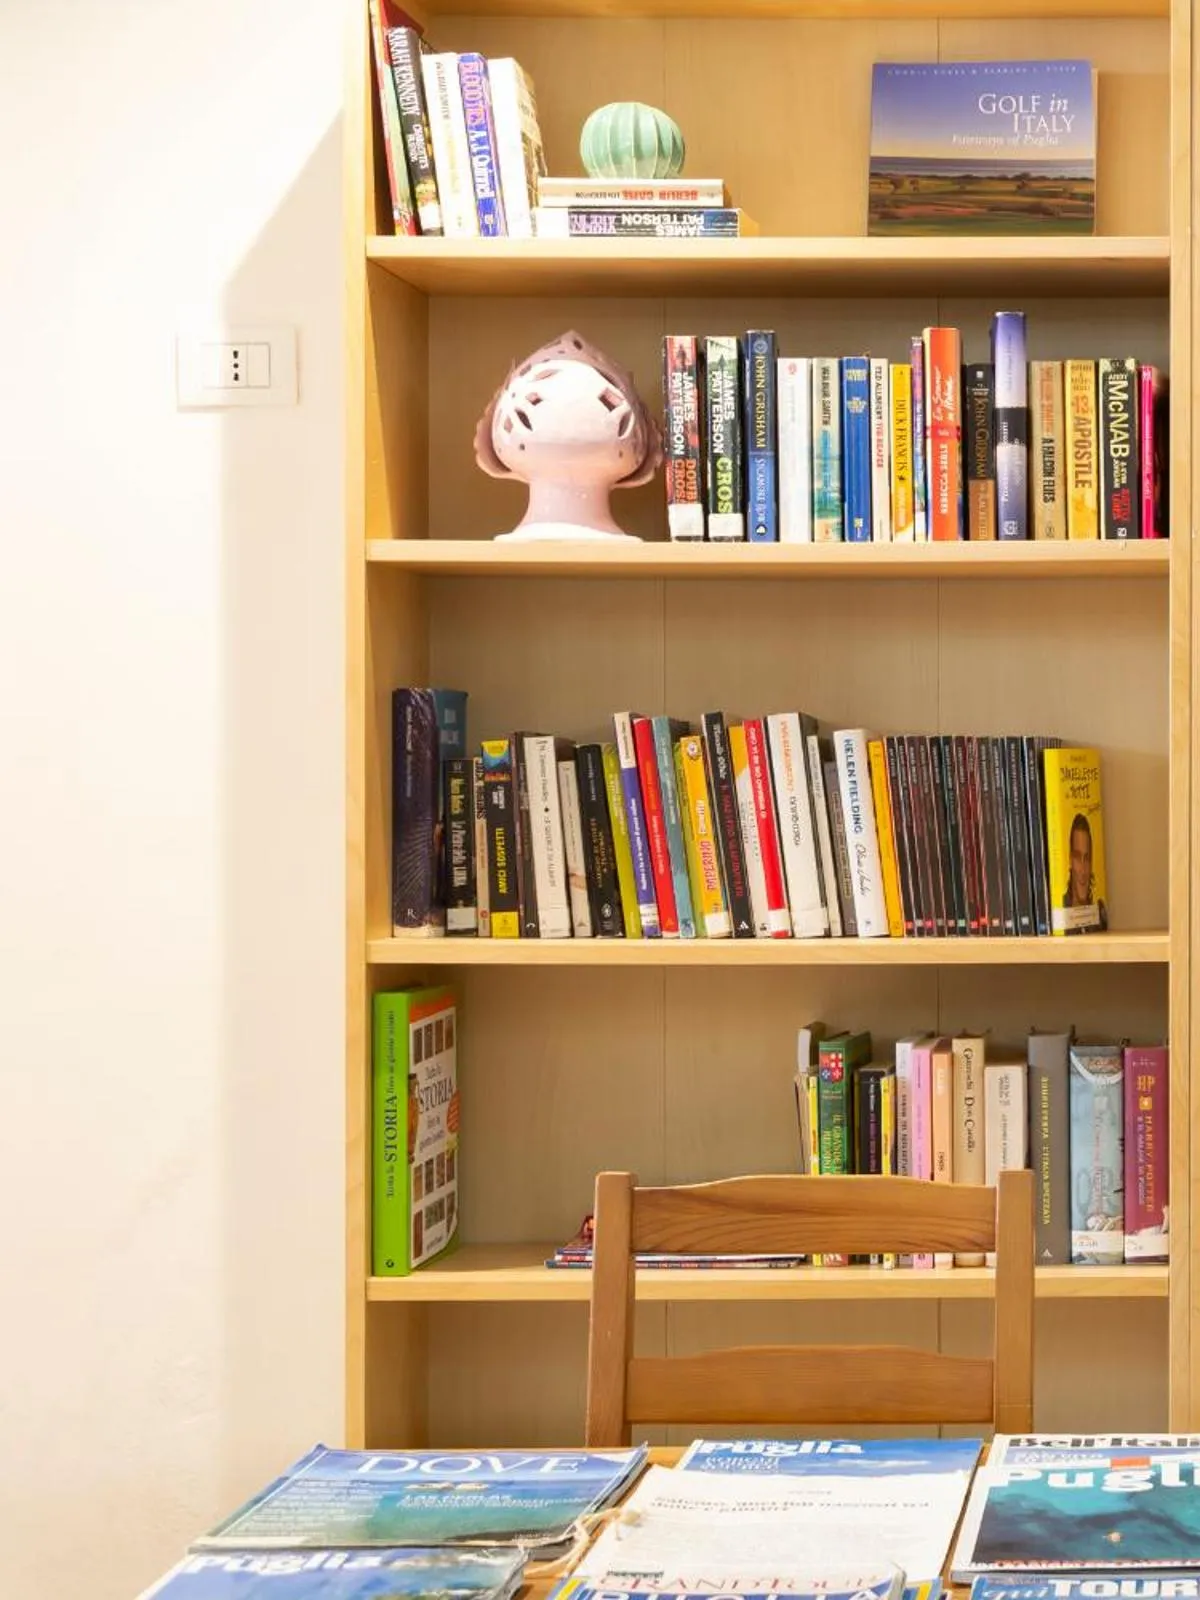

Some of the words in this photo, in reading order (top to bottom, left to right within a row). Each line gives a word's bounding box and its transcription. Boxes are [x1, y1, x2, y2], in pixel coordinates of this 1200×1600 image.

[978, 93, 1041, 114] GOLF
[1049, 93, 1069, 112] in
[1013, 113, 1076, 133] ITALY
[620, 213, 705, 226] PATTERSON
[655, 225, 703, 236] JAMES
[754, 355, 768, 390] JOHN
[671, 371, 685, 456] PATTERSON
[682, 371, 696, 422] JAMES
[711, 370, 724, 454] PATTERSON
[722, 370, 735, 420] JAMES
[895, 399, 907, 425] DICK
[974, 397, 988, 426] JOHN
[754, 392, 768, 448] GRISHAM
[1107, 379, 1130, 458] McNAB
[895, 428, 907, 472] FRANCIS
[974, 428, 990, 477] GRISHAM
[1074, 416, 1092, 488] APOSTLE
[686, 459, 698, 503] DOUB
[716, 457, 733, 513] CROS
[1042, 479, 1056, 504] FLIES
[843, 738, 857, 777] HELEN
[847, 780, 863, 834] FIELDING
[383, 1095, 398, 1162] STORIA
[357, 1456, 588, 1474] DOVE
